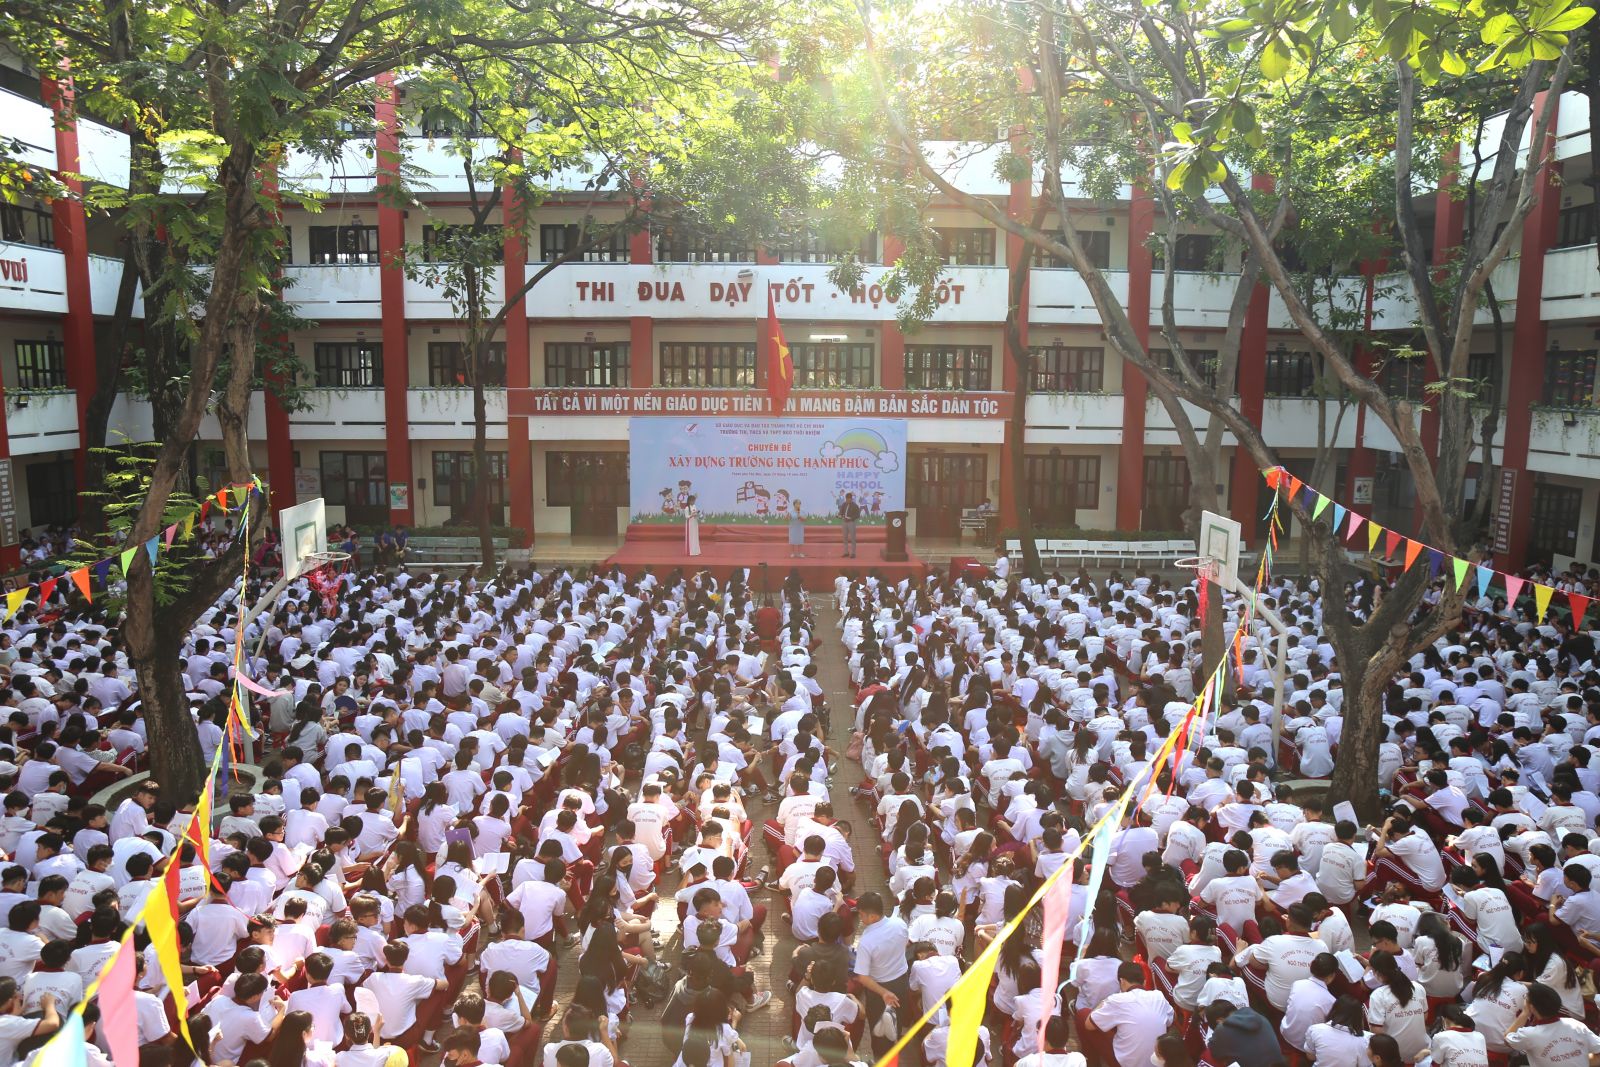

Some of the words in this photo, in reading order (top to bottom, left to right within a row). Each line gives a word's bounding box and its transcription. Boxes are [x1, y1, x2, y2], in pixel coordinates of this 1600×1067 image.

[576, 281, 615, 302] THI
[637, 281, 685, 302] ĐUA
[710, 281, 752, 307] DẠY
[771, 276, 815, 303] TỐT
[934, 278, 964, 304] ỐT
[562, 392, 580, 411] CẢ
[584, 393, 597, 411] VÌ
[601, 393, 630, 414] MỘT
[665, 393, 697, 412] GIÁO
[701, 397, 728, 415] DỤC
[766, 397, 796, 412] TN
[800, 398, 841, 412] MANG
[844, 395, 875, 415] ĐẬM
[879, 394, 907, 413] BẢN
[911, 394, 938, 413] SẮC
[942, 396, 970, 414] DÂN
[973, 397, 999, 417] TỘC
[748, 442, 779, 452] CHUYÊN
[668, 455, 692, 468] XÂY
[694, 455, 726, 469] DỰNG
[729, 455, 774, 468] TRƯỜNG
[777, 457, 800, 469] HỌC
[804, 457, 836, 470] HẠNH
[839, 456, 869, 469] PHÚC
[836, 471, 880, 480] HAPPY
[835, 481, 884, 490] SCHOOL
